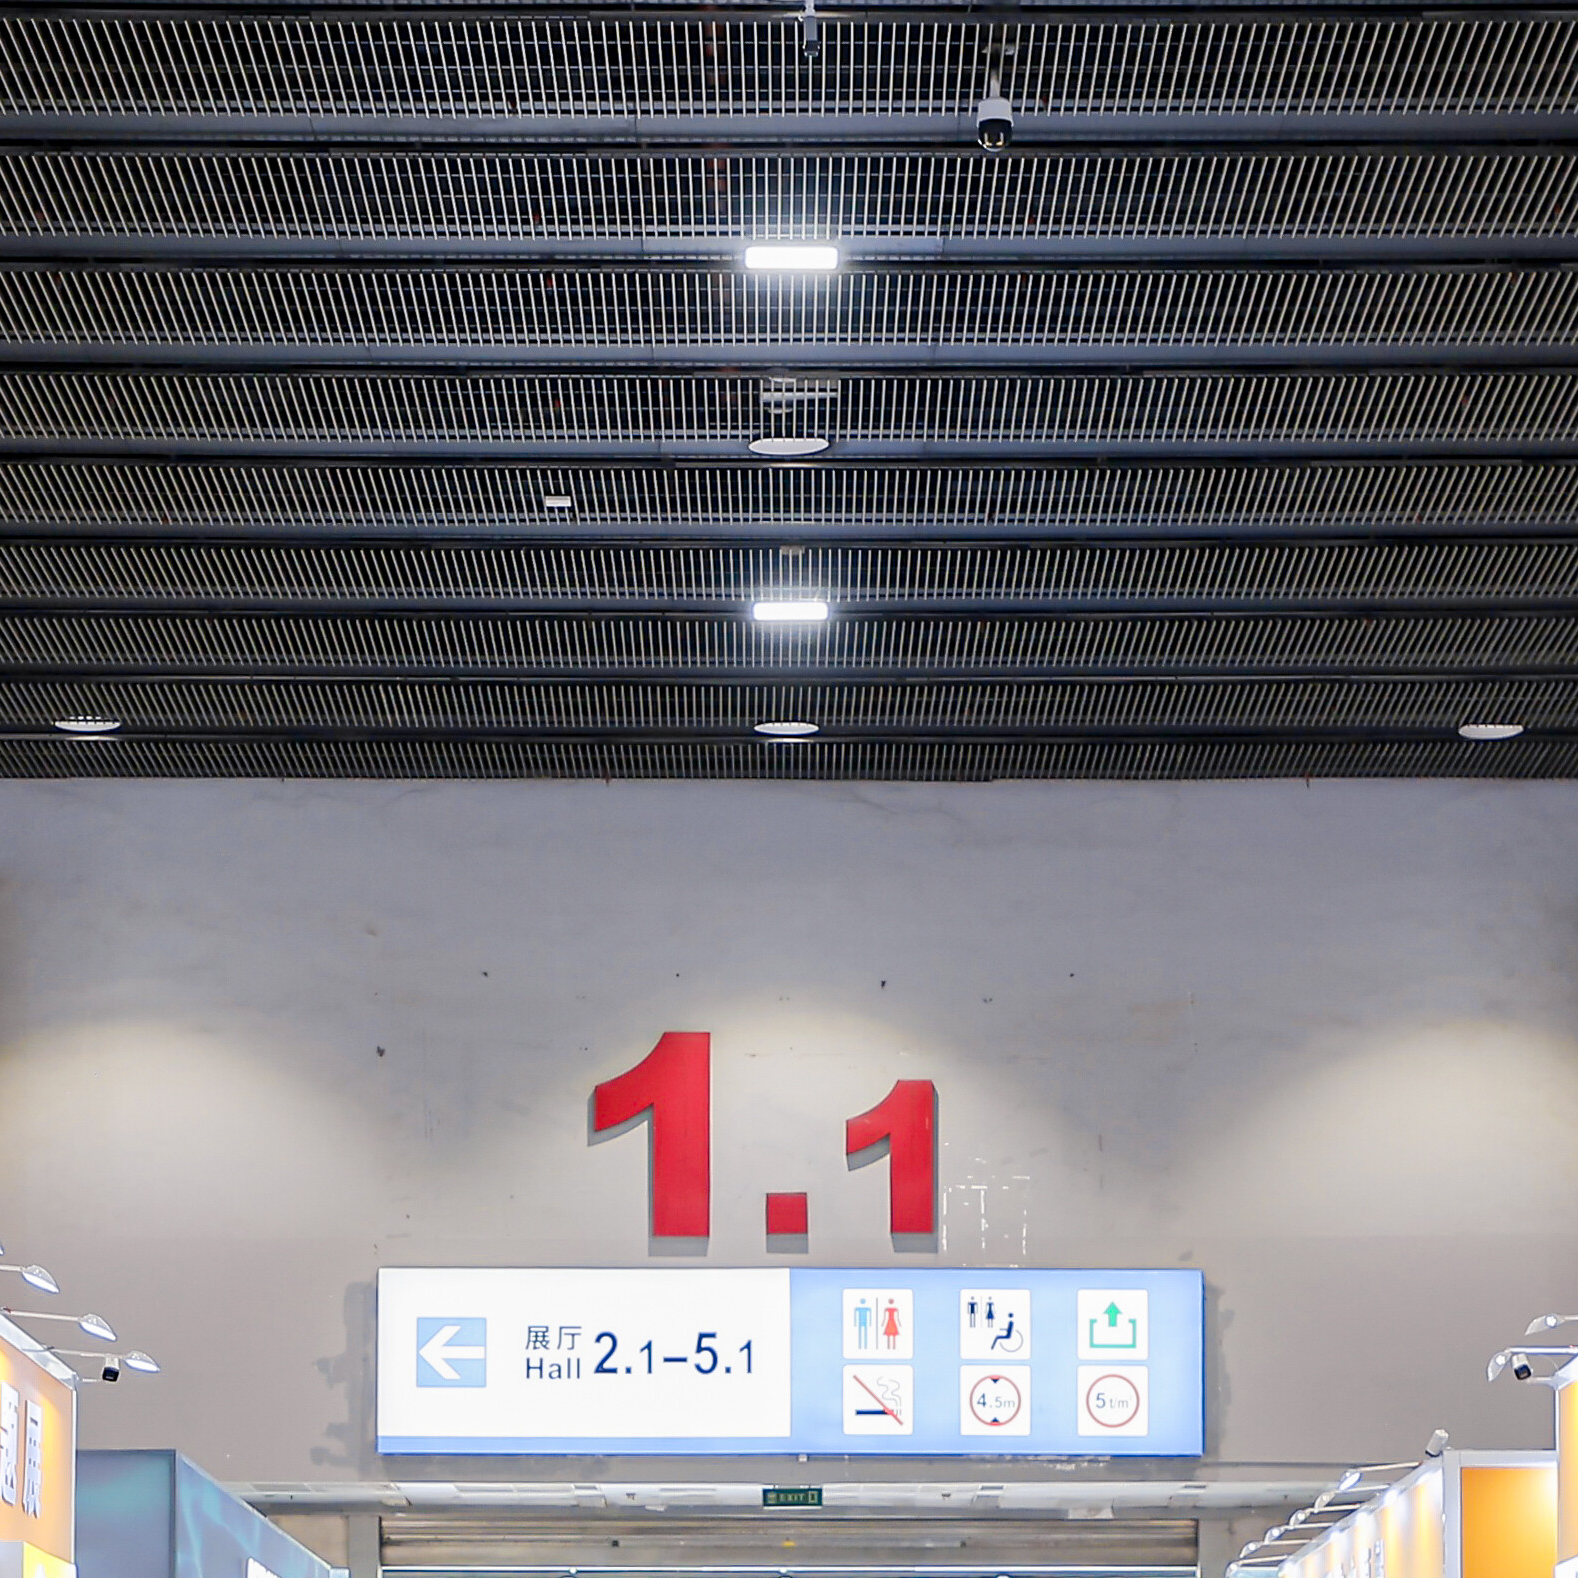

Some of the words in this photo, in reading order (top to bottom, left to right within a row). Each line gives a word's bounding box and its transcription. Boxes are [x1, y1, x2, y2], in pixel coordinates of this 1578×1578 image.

[592, 1031, 940, 1239] 1.1
[525, 1325, 583, 1351] 展厅
[525, 1357, 581, 1380] Hall
